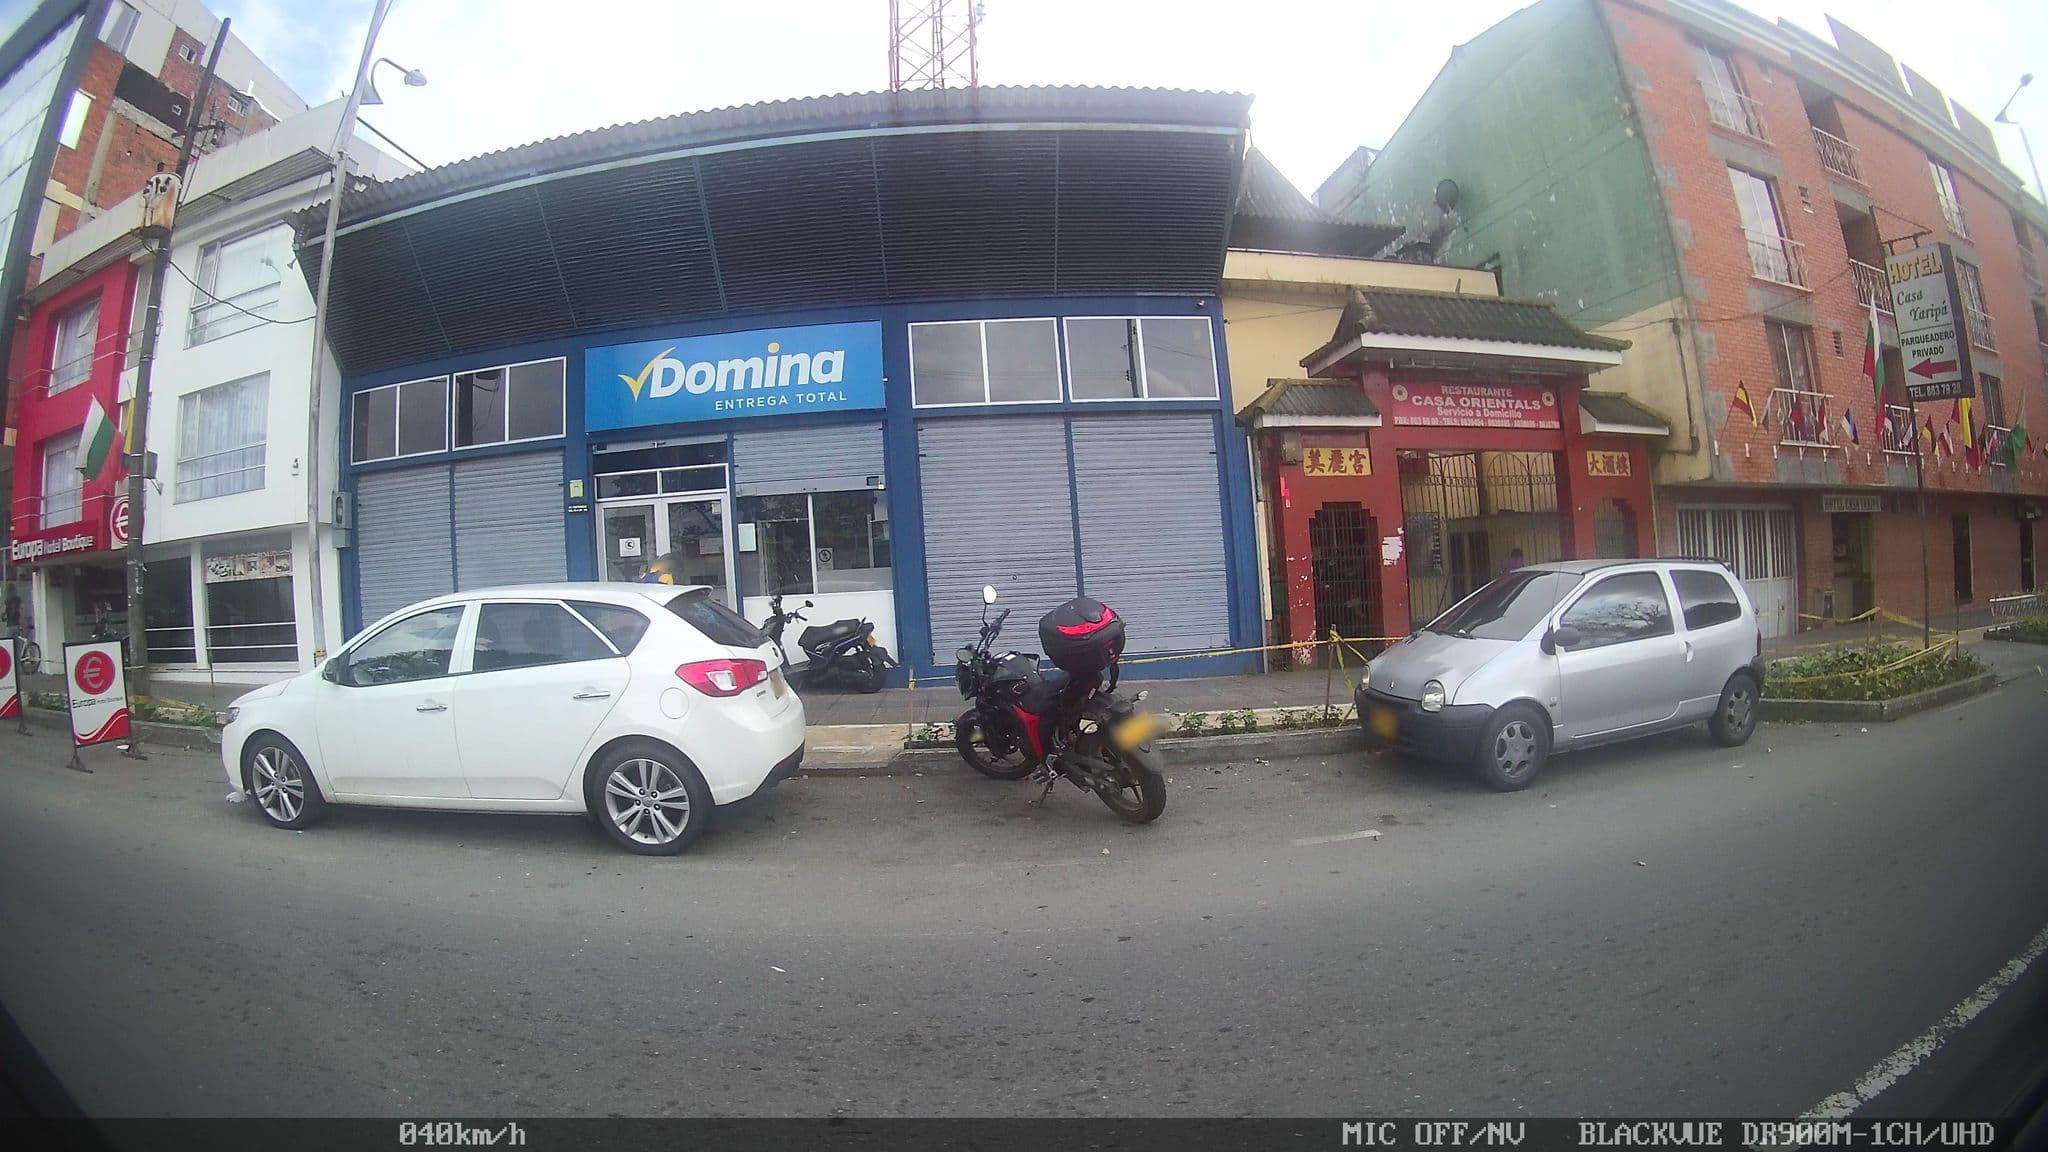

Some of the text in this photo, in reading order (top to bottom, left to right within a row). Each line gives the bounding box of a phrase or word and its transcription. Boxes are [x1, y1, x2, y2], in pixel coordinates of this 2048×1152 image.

[1889, 252, 1943, 285] HOTEL
[1897, 290, 1924, 306] Casa
[1910, 300, 1948, 322] Yaripá
[1901, 330, 1955, 347] PARQUEADERO
[1912, 346, 1945, 358] PRIVADO
[650, 342, 845, 399] Domina
[1441, 385, 1513, 397] RESTAURANTE
[1909, 387, 1925, 398] TEL.
[1942, 383, 1951, 395] 79
[715, 390, 847, 411] ENTREGA TOTAL
[1411, 395, 1541, 411] CASA ORIENTALS
[1436, 406, 1474, 417] Servicio
[1484, 408, 1522, 419] Domicilio
[12, 540, 43, 562] Europa
[62, 534, 94, 551] Boutique
